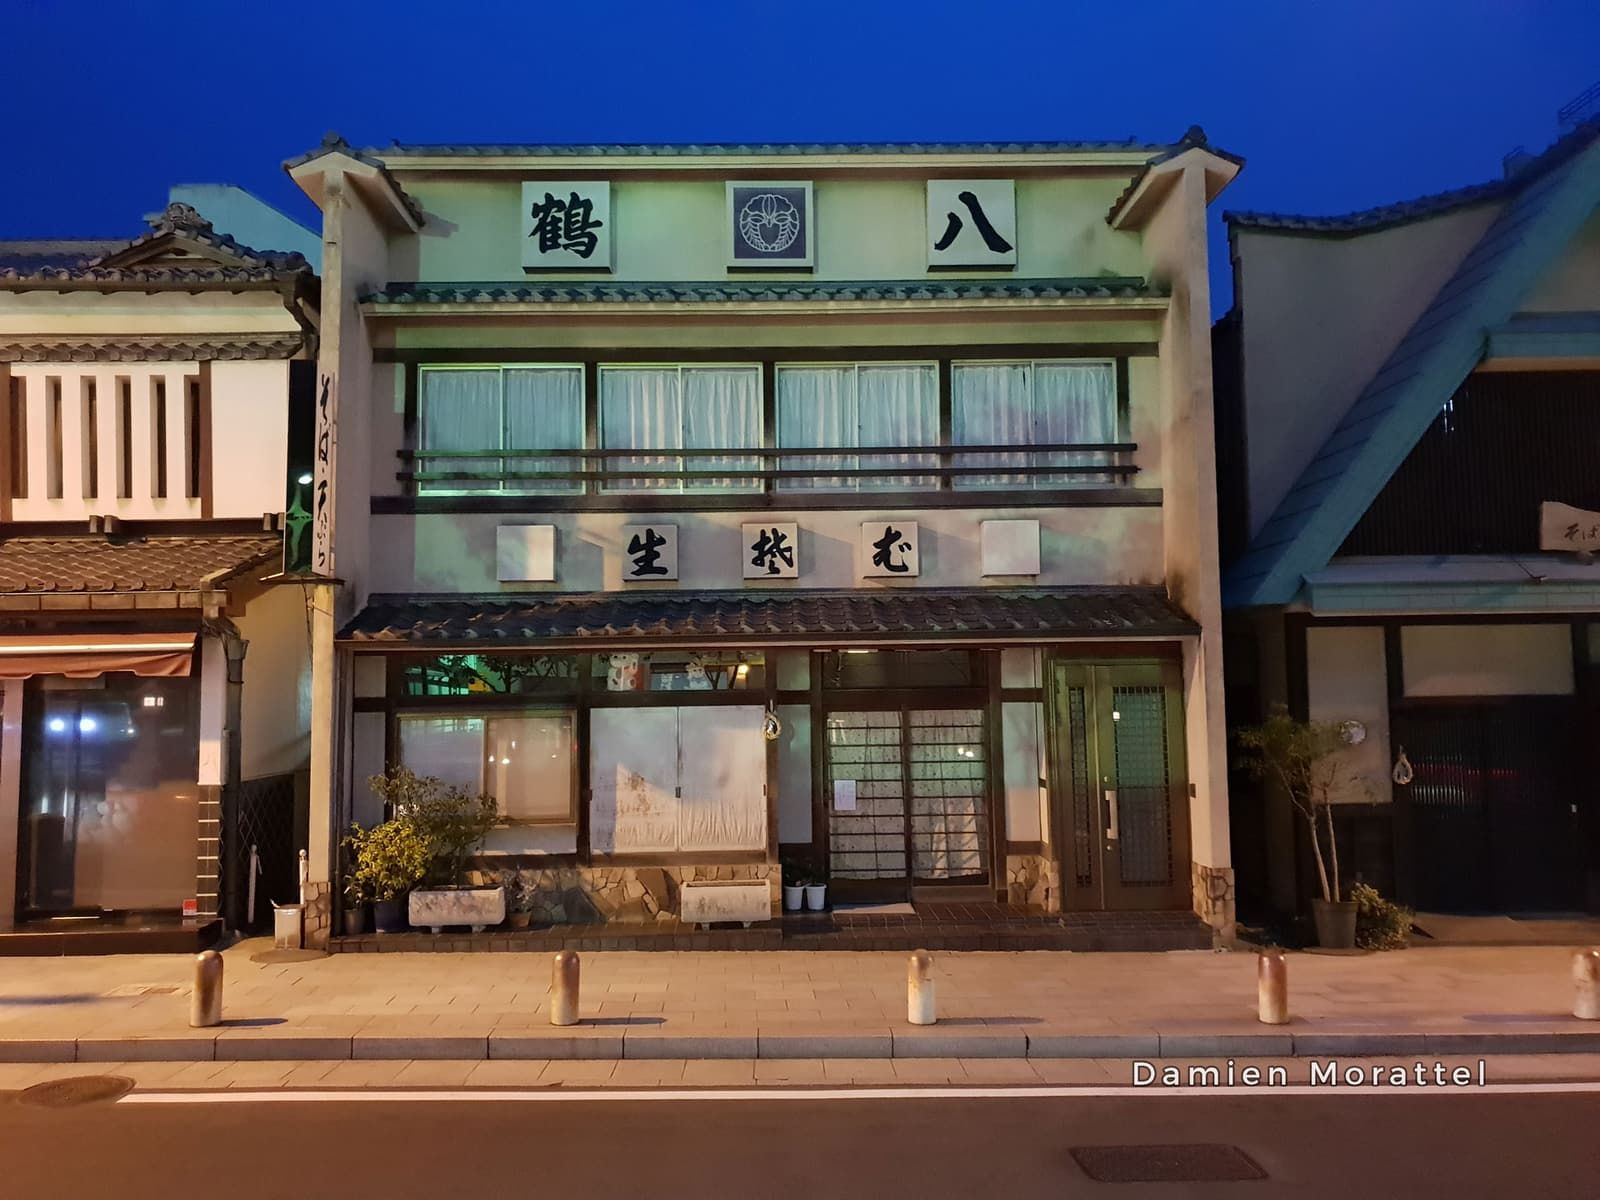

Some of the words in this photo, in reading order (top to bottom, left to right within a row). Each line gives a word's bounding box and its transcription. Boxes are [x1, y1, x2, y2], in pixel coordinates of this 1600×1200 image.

[528, 192, 603, 258] 鶴
[934, 191, 1015, 253] 八
[628, 527, 668, 576] 生
